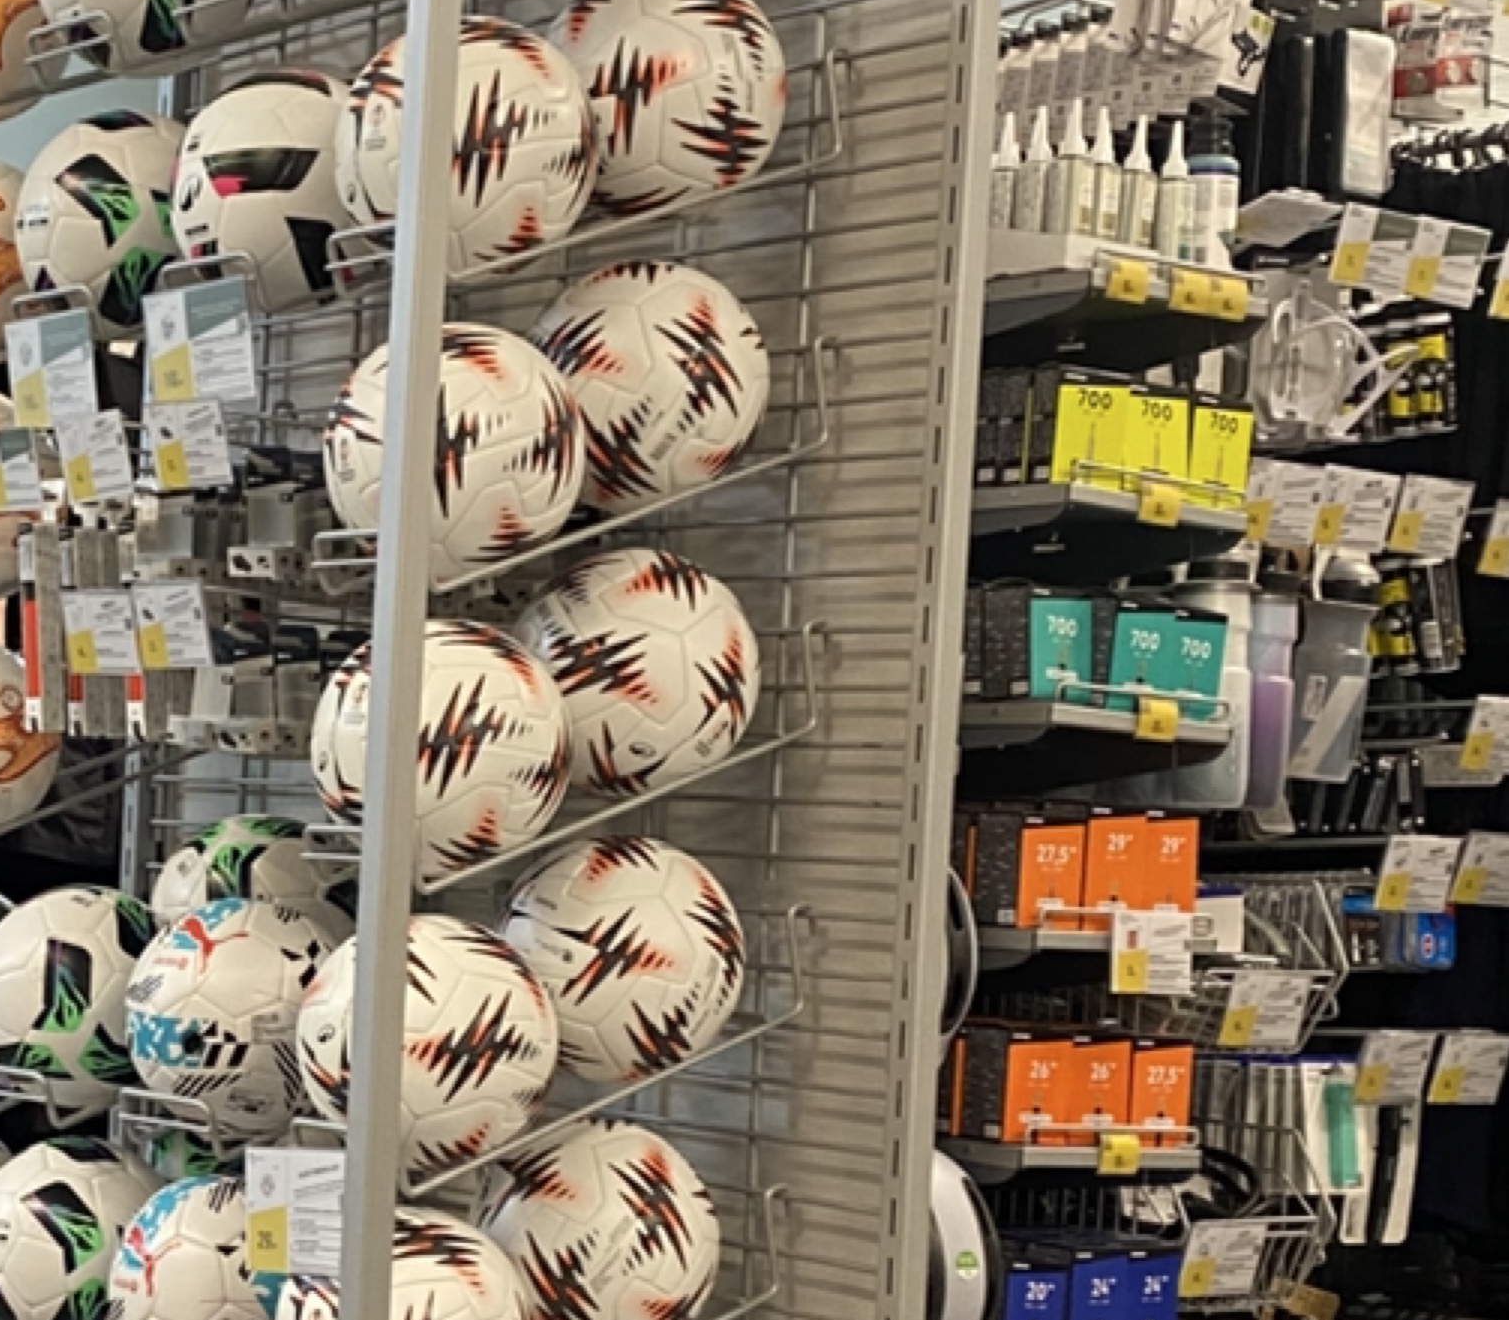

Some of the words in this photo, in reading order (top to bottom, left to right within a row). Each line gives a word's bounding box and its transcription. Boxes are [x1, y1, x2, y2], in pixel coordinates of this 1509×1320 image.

[1078, 388, 1113, 410] 700
[1141, 399, 1173, 422] 700
[1210, 412, 1239, 433] 700
[1046, 615, 1078, 637] 700
[1130, 628, 1161, 650] 700
[1180, 636, 1211, 659] 700
